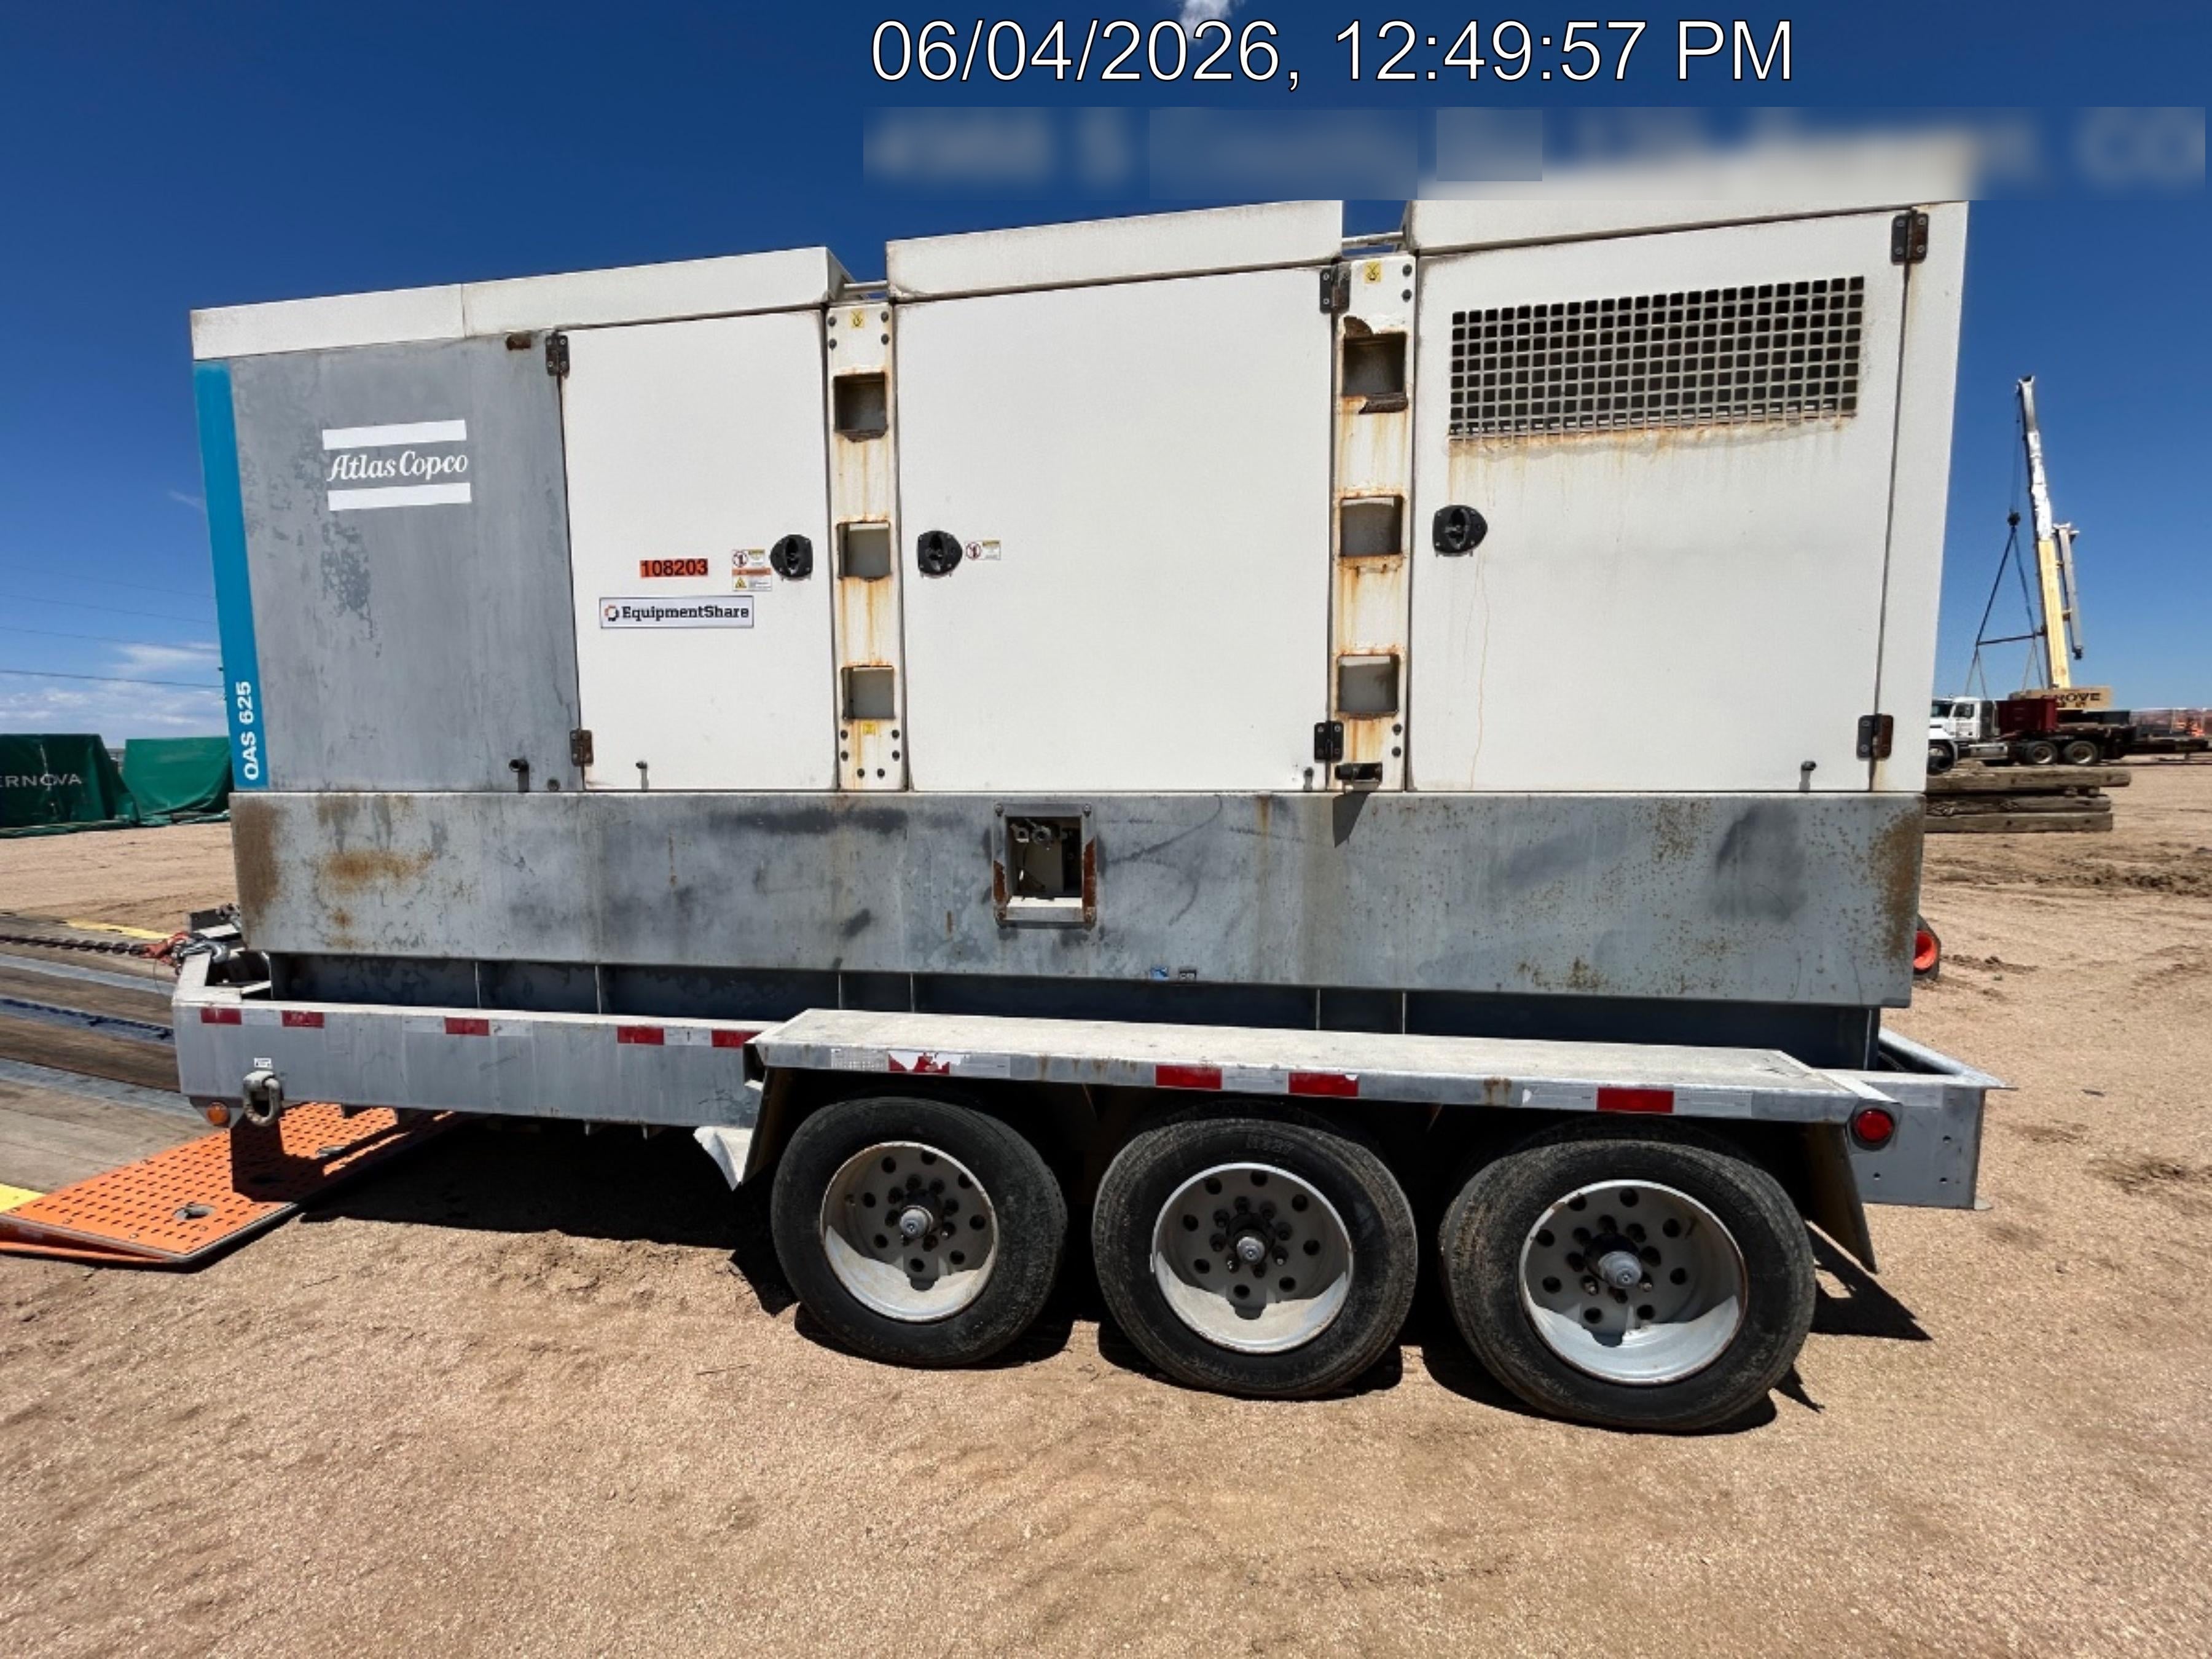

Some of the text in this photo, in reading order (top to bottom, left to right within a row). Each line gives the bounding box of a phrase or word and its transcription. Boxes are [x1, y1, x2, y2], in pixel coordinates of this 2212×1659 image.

[326, 450, 468, 482] Atlas Copco
[640, 559, 708, 578] 108203
[621, 605, 749, 621] EquipmentShare
[236, 681, 259, 780] OAS 625
